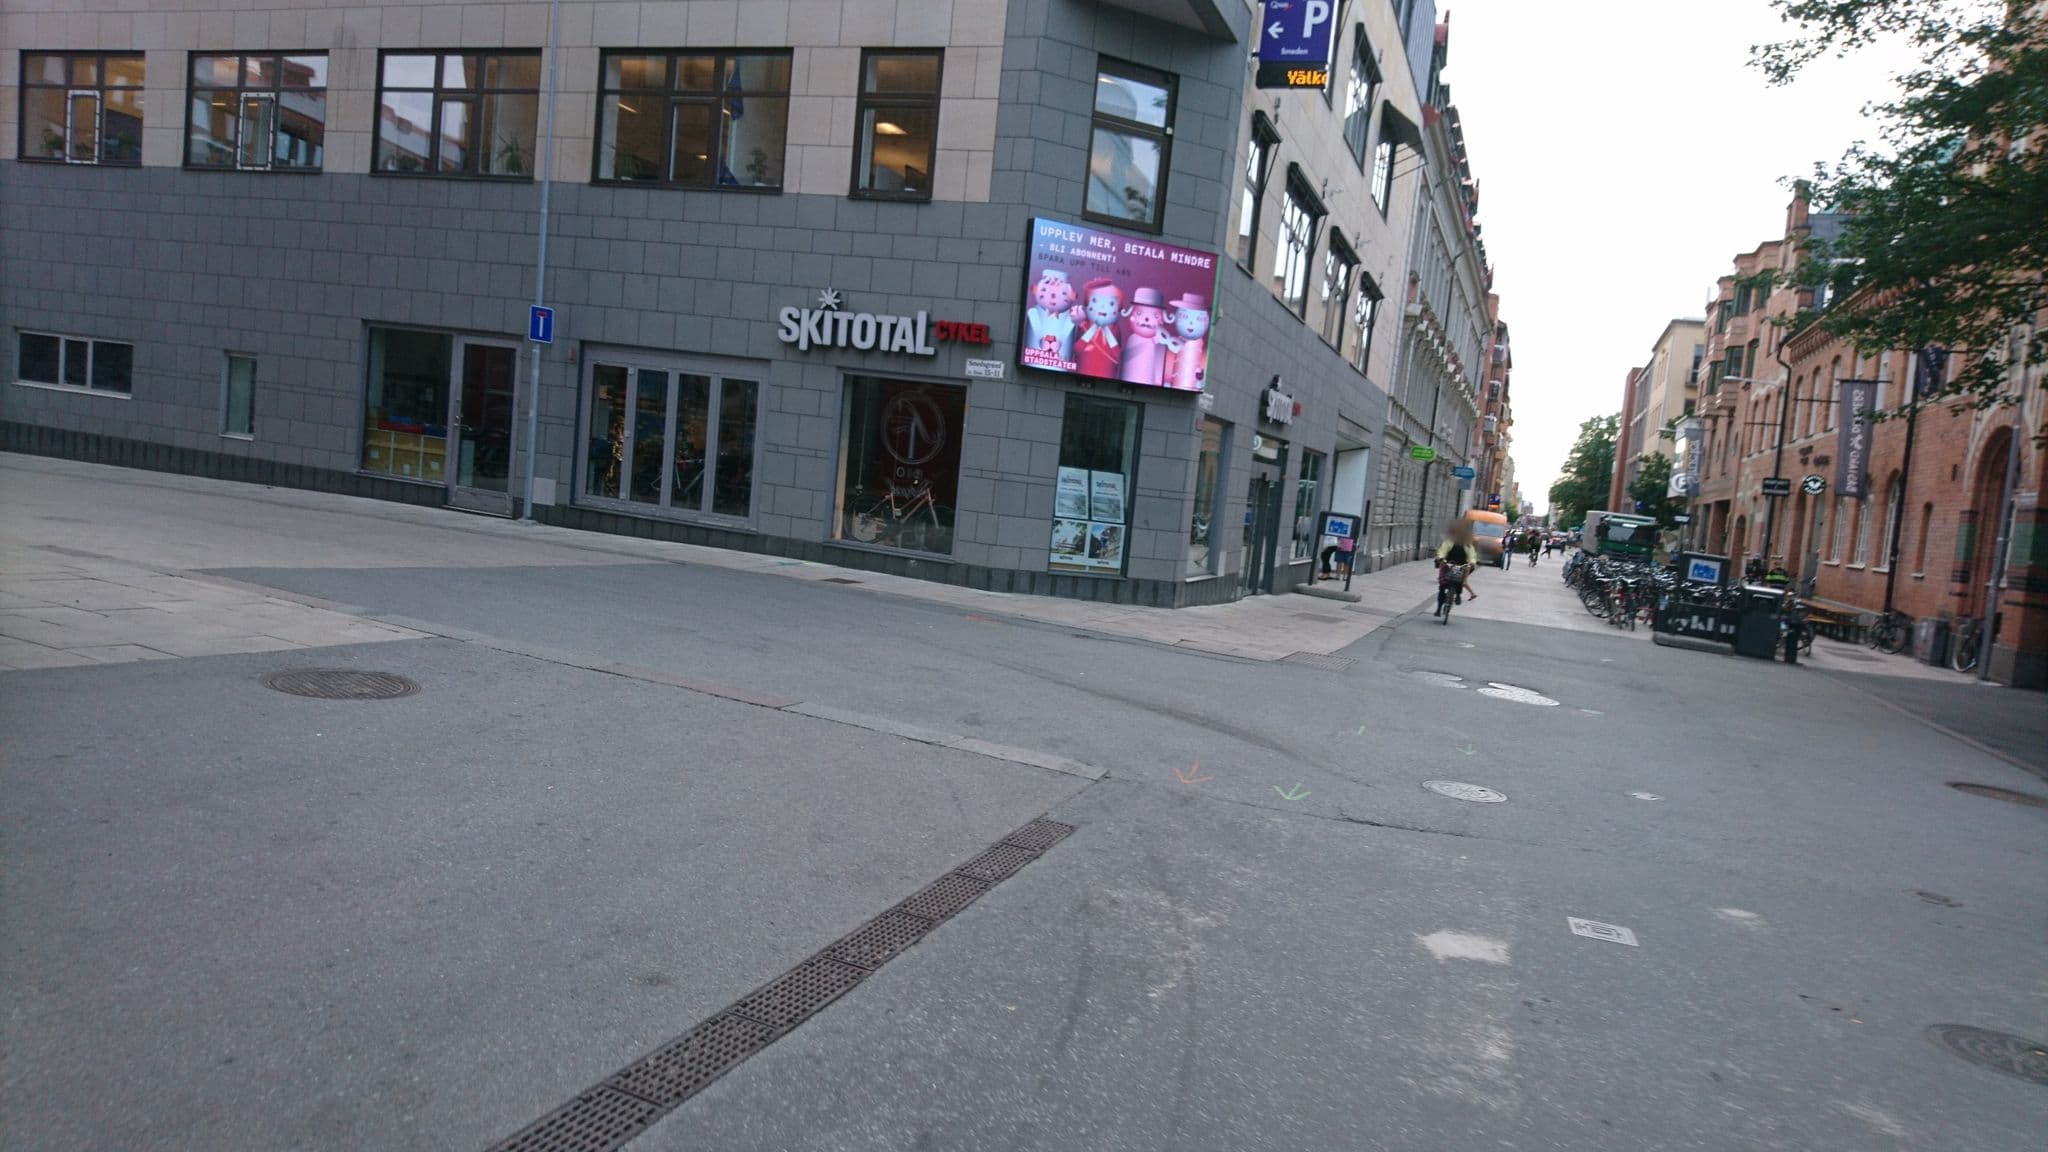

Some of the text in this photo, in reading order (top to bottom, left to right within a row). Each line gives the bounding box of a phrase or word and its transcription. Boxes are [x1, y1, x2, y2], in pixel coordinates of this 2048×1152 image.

[1303, 0, 1329, 38] P
[1040, 226, 1212, 269] UPPLEV MER, BETALA MINDRE
[1049, 243, 1065, 253] BLI
[777, 306, 991, 355] SKITOTAL CYKEL
